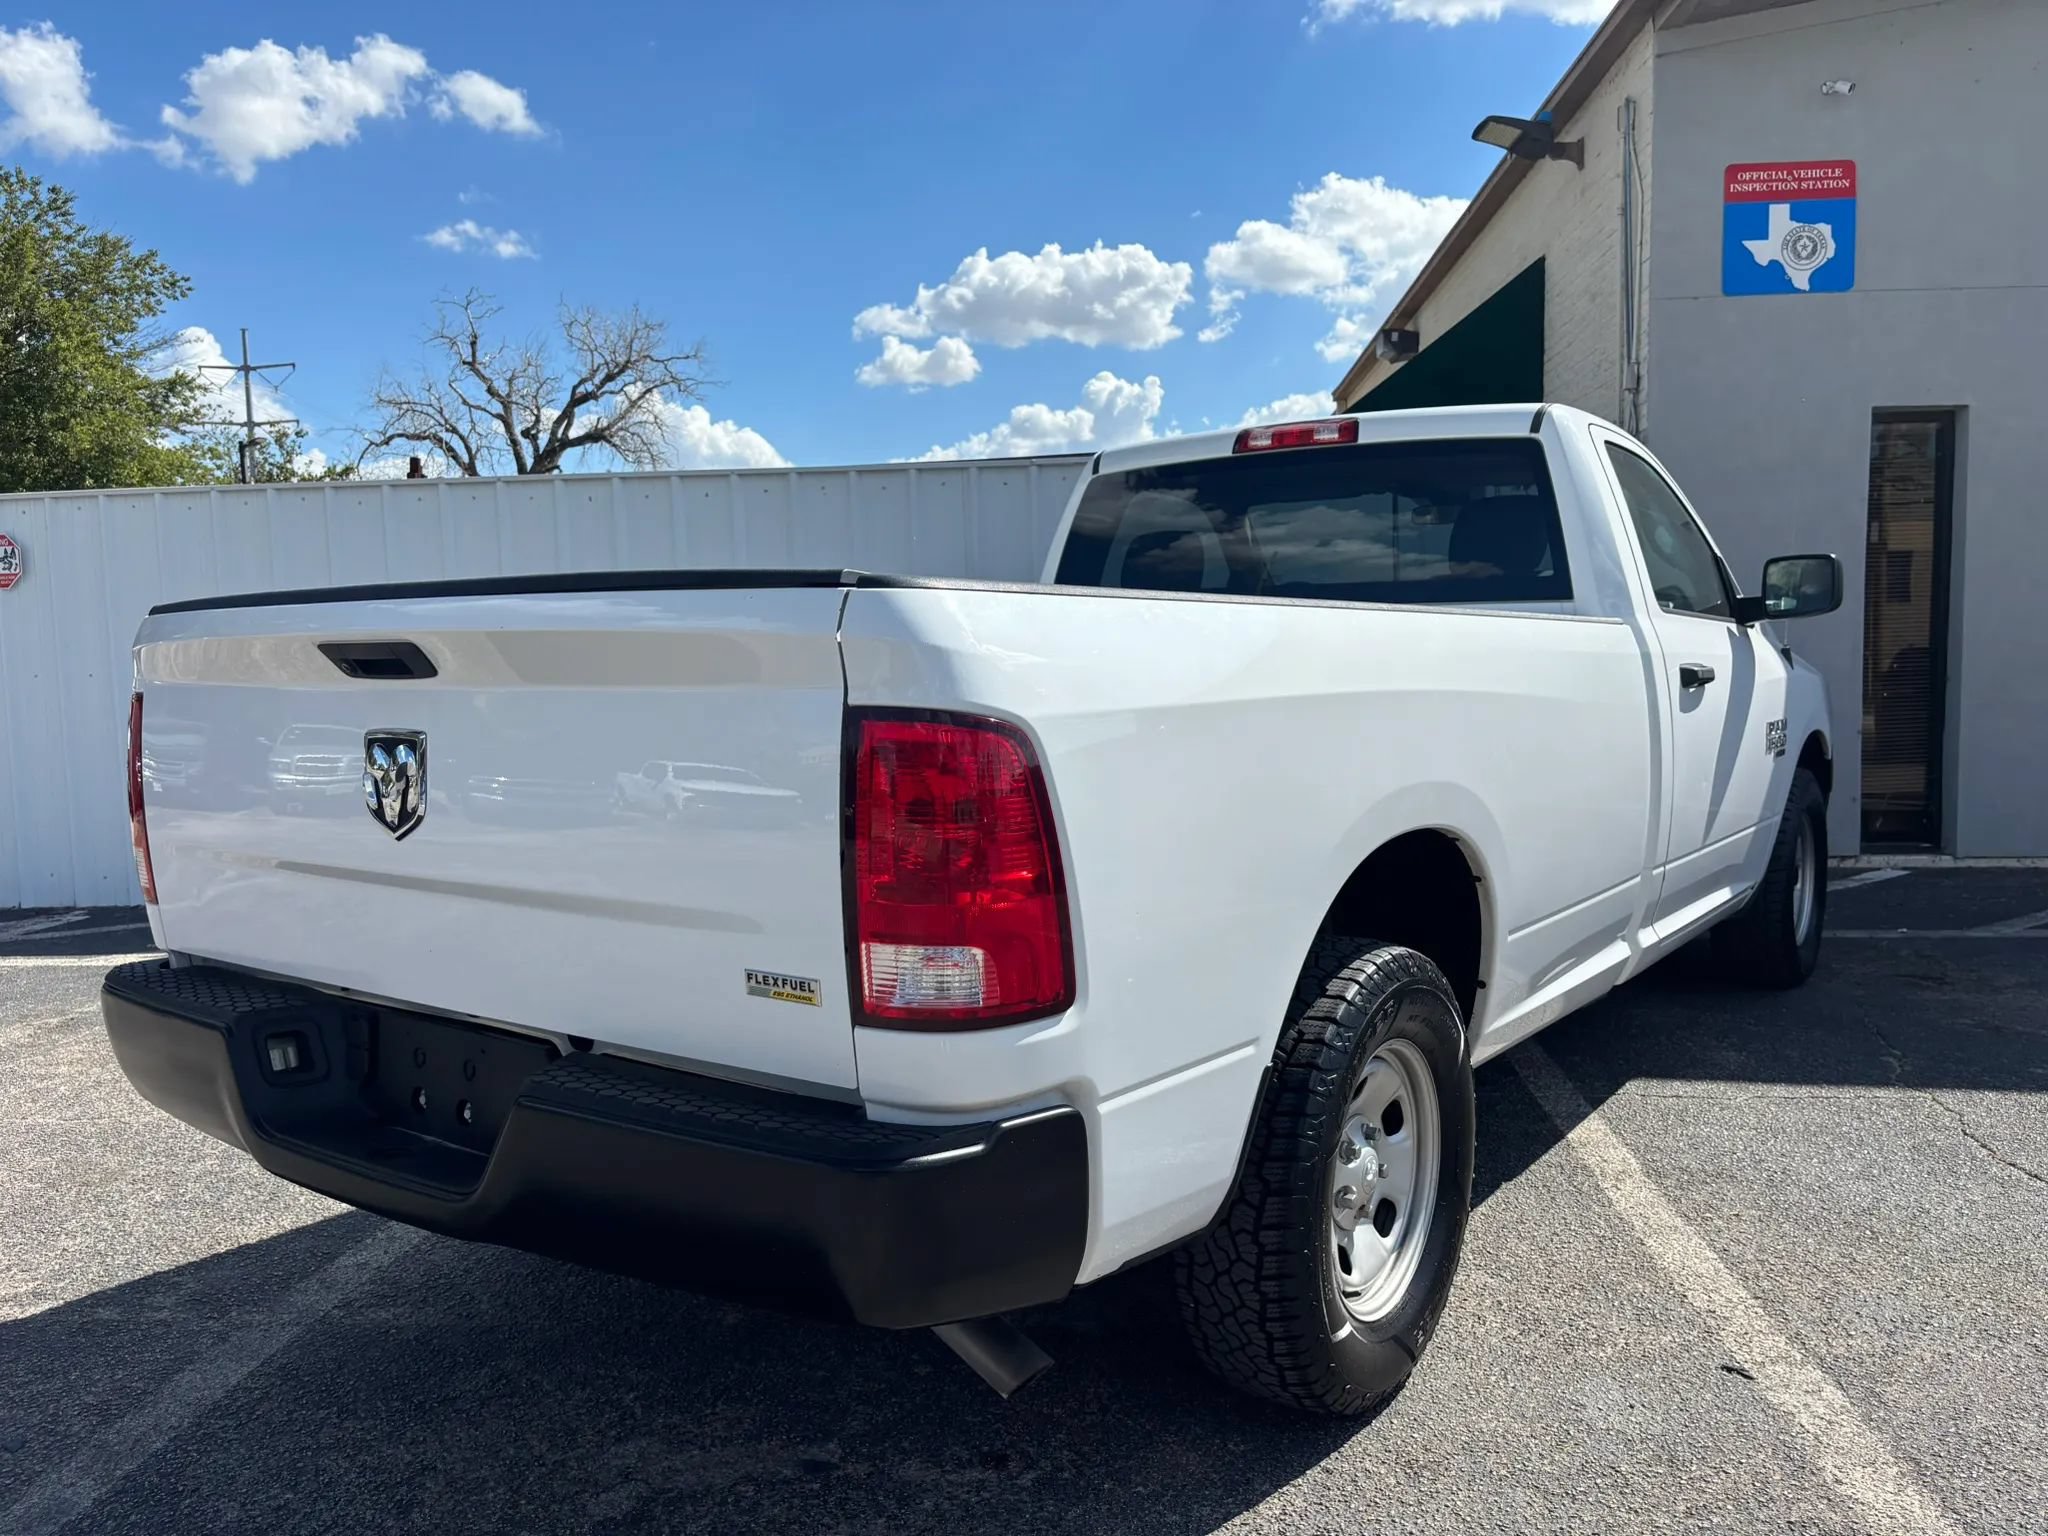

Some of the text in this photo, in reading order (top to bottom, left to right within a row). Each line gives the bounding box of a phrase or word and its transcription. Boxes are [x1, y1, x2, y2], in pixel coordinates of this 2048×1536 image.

[1738, 168, 1843, 181] OFFICIAL VEHICLE
[1730, 179, 1850, 192] INSPECTION STATION
[747, 973, 815, 993] FLEXFUEL
[785, 992, 813, 1002] ETHANOL
